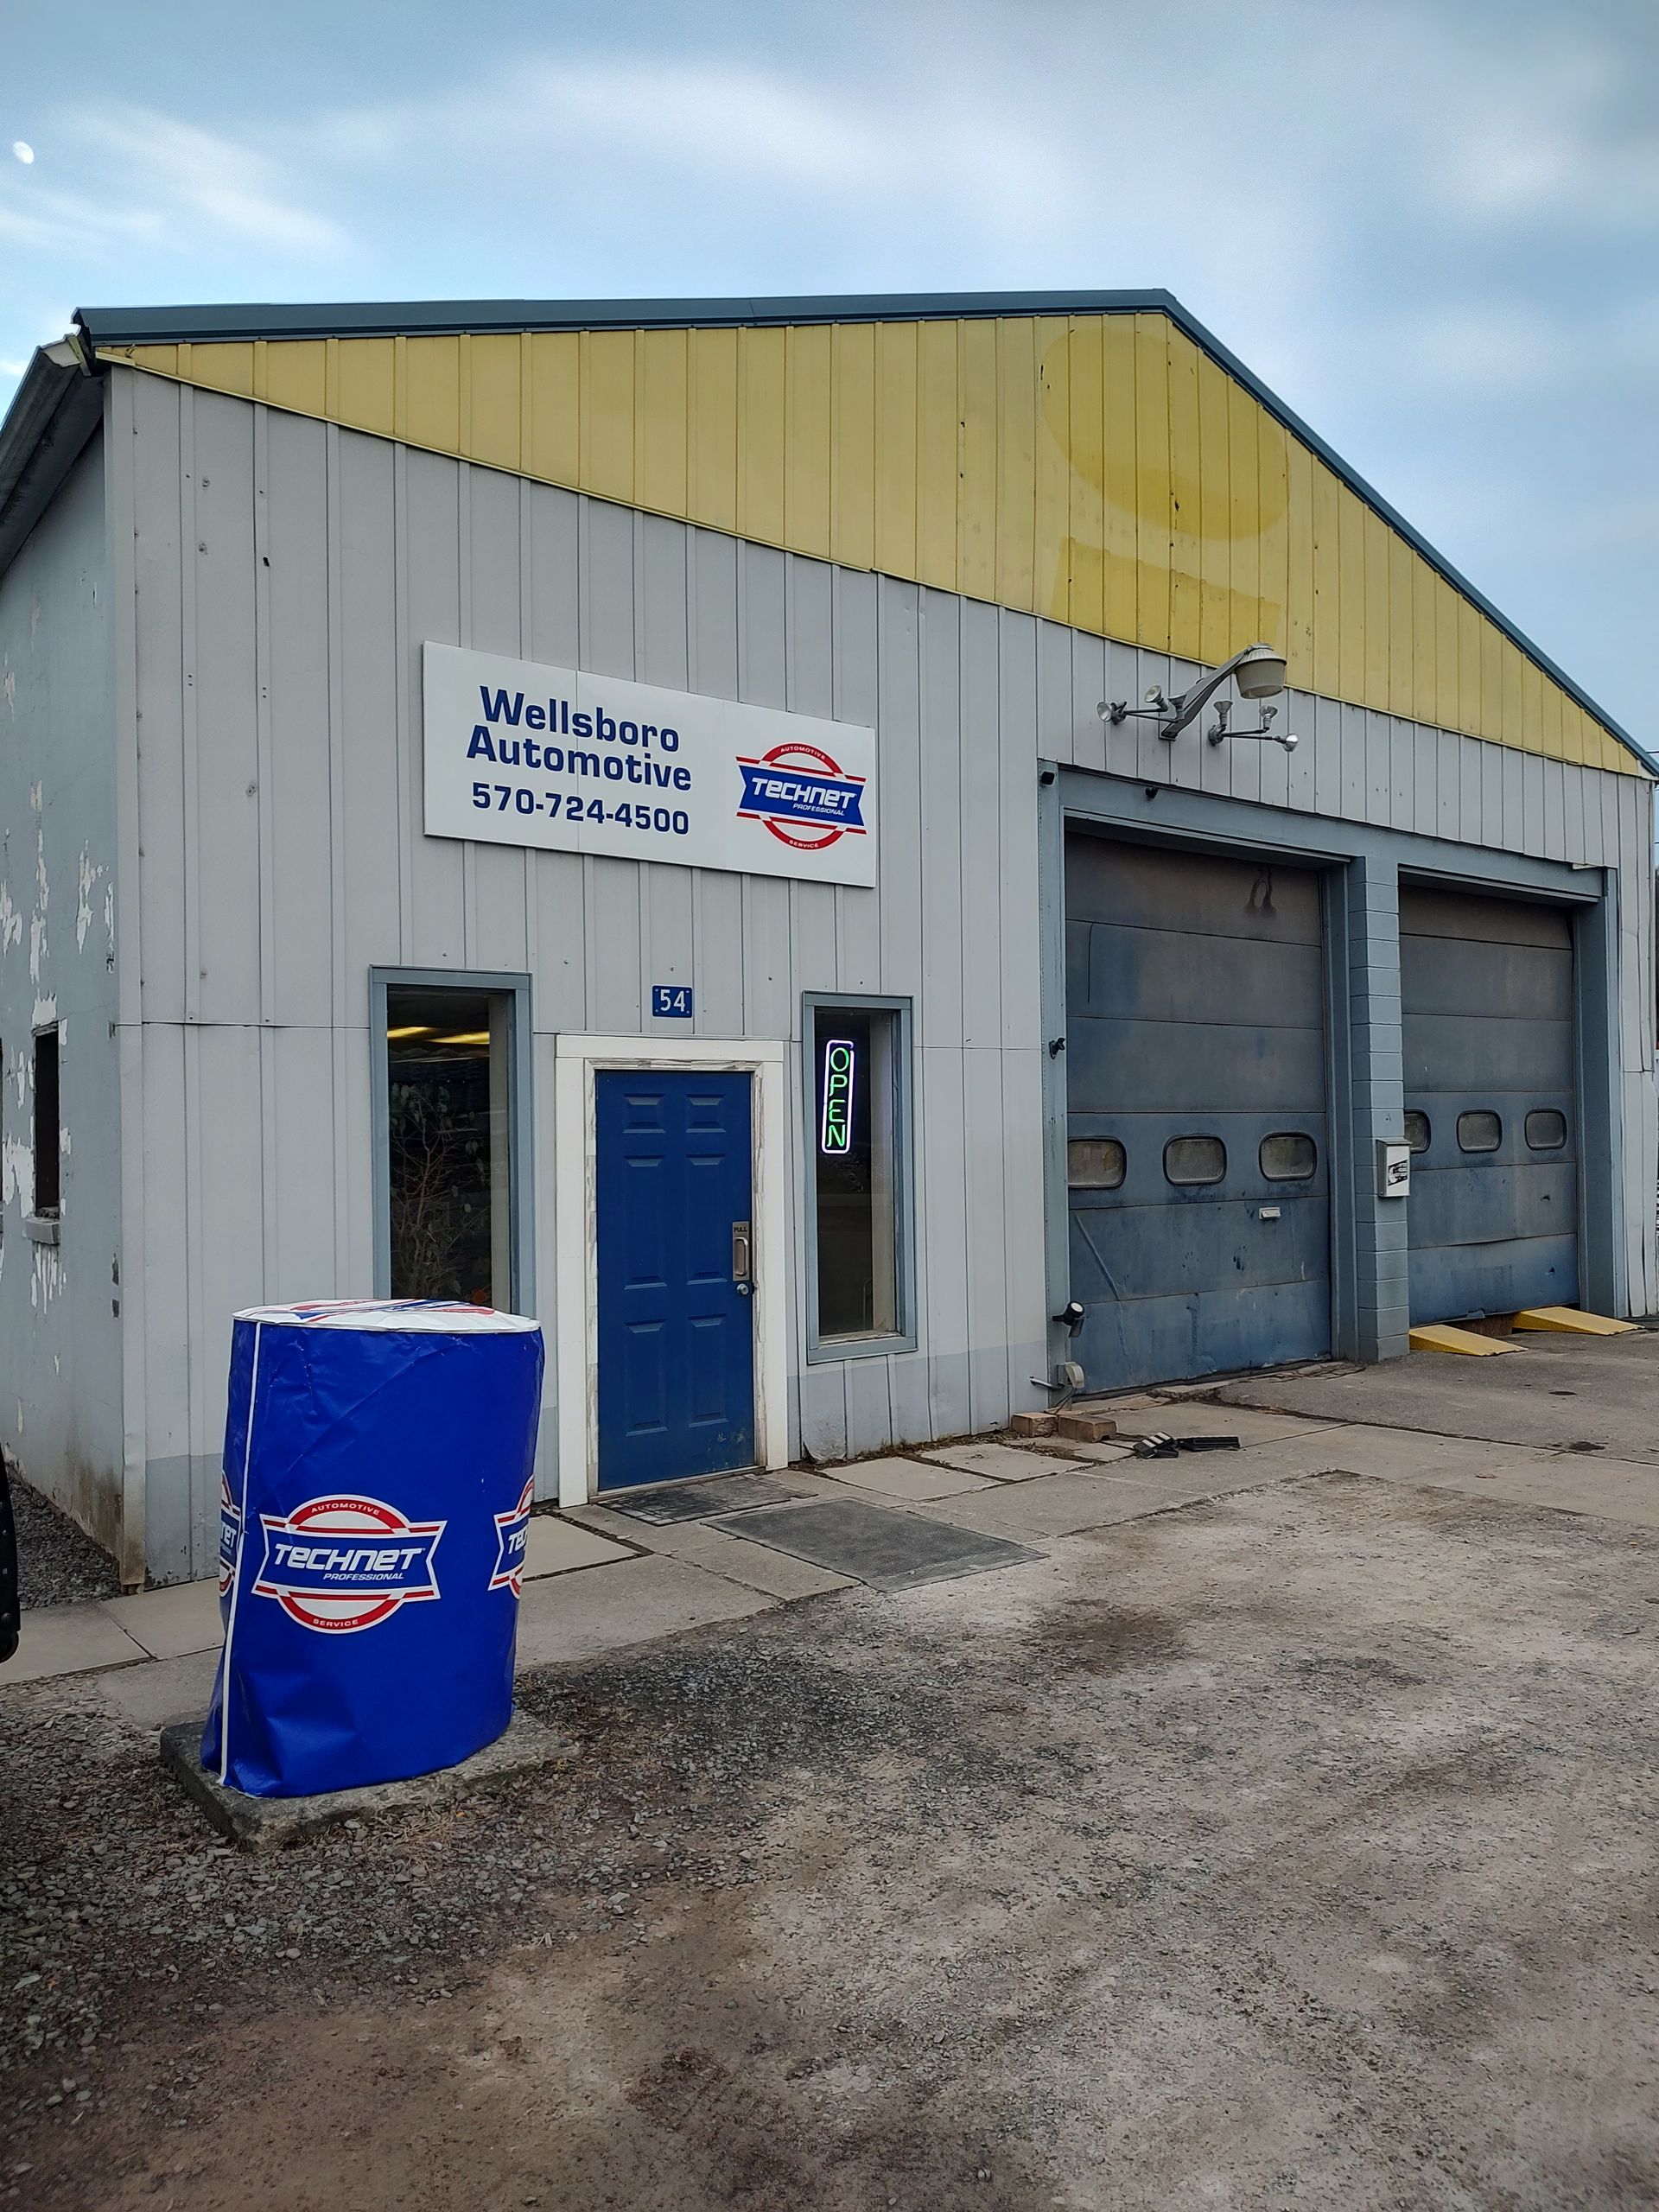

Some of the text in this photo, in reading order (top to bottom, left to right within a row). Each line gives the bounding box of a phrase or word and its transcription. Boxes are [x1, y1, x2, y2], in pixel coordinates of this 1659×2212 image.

[480, 685, 680, 753] Wellsboro
[467, 724, 692, 791] Automotive
[780, 746, 826, 760] AUTOMOTIVE
[752, 777, 857, 809] TECHNET
[472, 781, 690, 835] 570-724-4500
[792, 803, 845, 817] PROFESSIONAL
[789, 839, 819, 849] SERVICE
[660, 988, 685, 1012] 54
[826, 1046, 849, 1147] OPEN
[311, 1503, 381, 1516] AUTOMOTIVE
[274, 1543, 423, 1572] TECHNET
[313, 1618, 359, 1628] SERVICE
